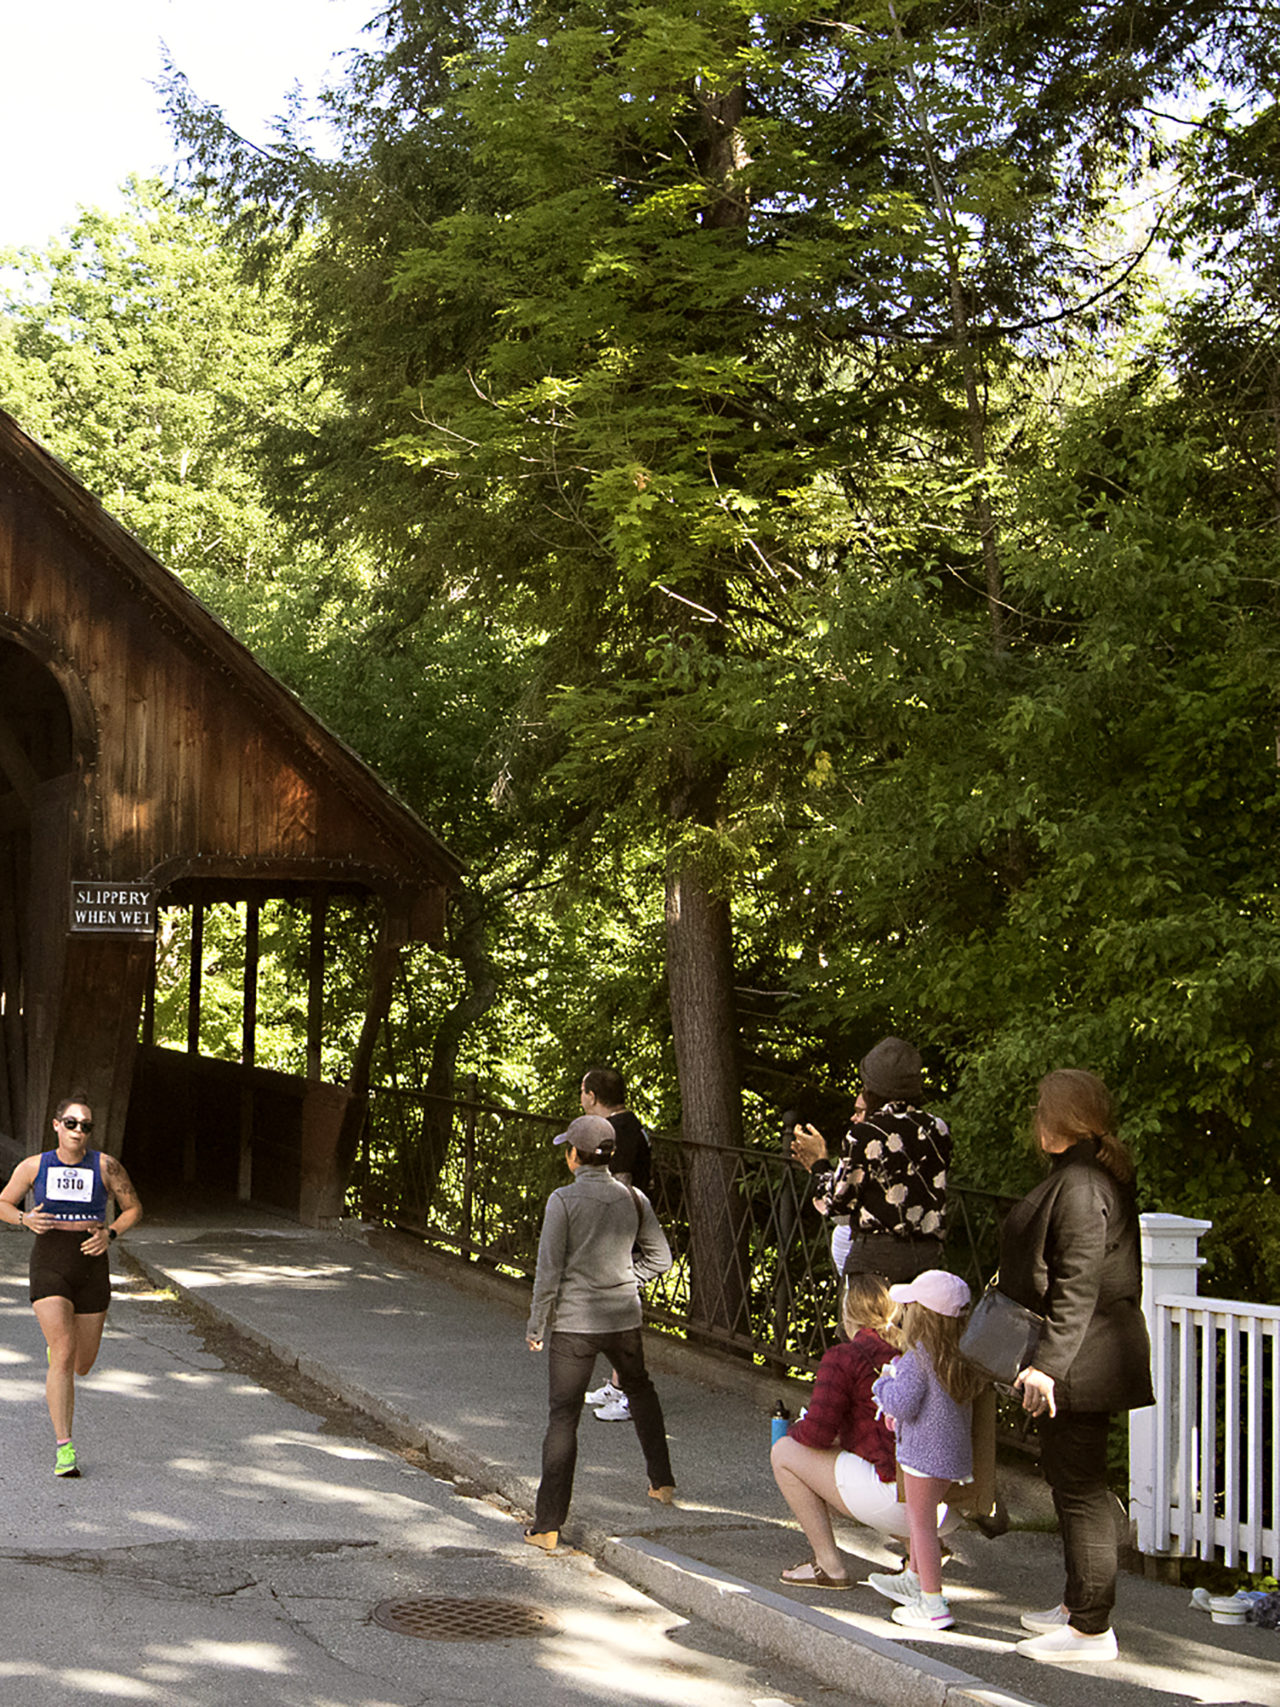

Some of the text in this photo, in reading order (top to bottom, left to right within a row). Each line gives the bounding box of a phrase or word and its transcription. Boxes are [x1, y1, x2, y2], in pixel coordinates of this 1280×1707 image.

[76, 890, 150, 906] SLIPPERY
[74, 910, 151, 925] WHEN WET
[57, 1178, 84, 1190] 1310
